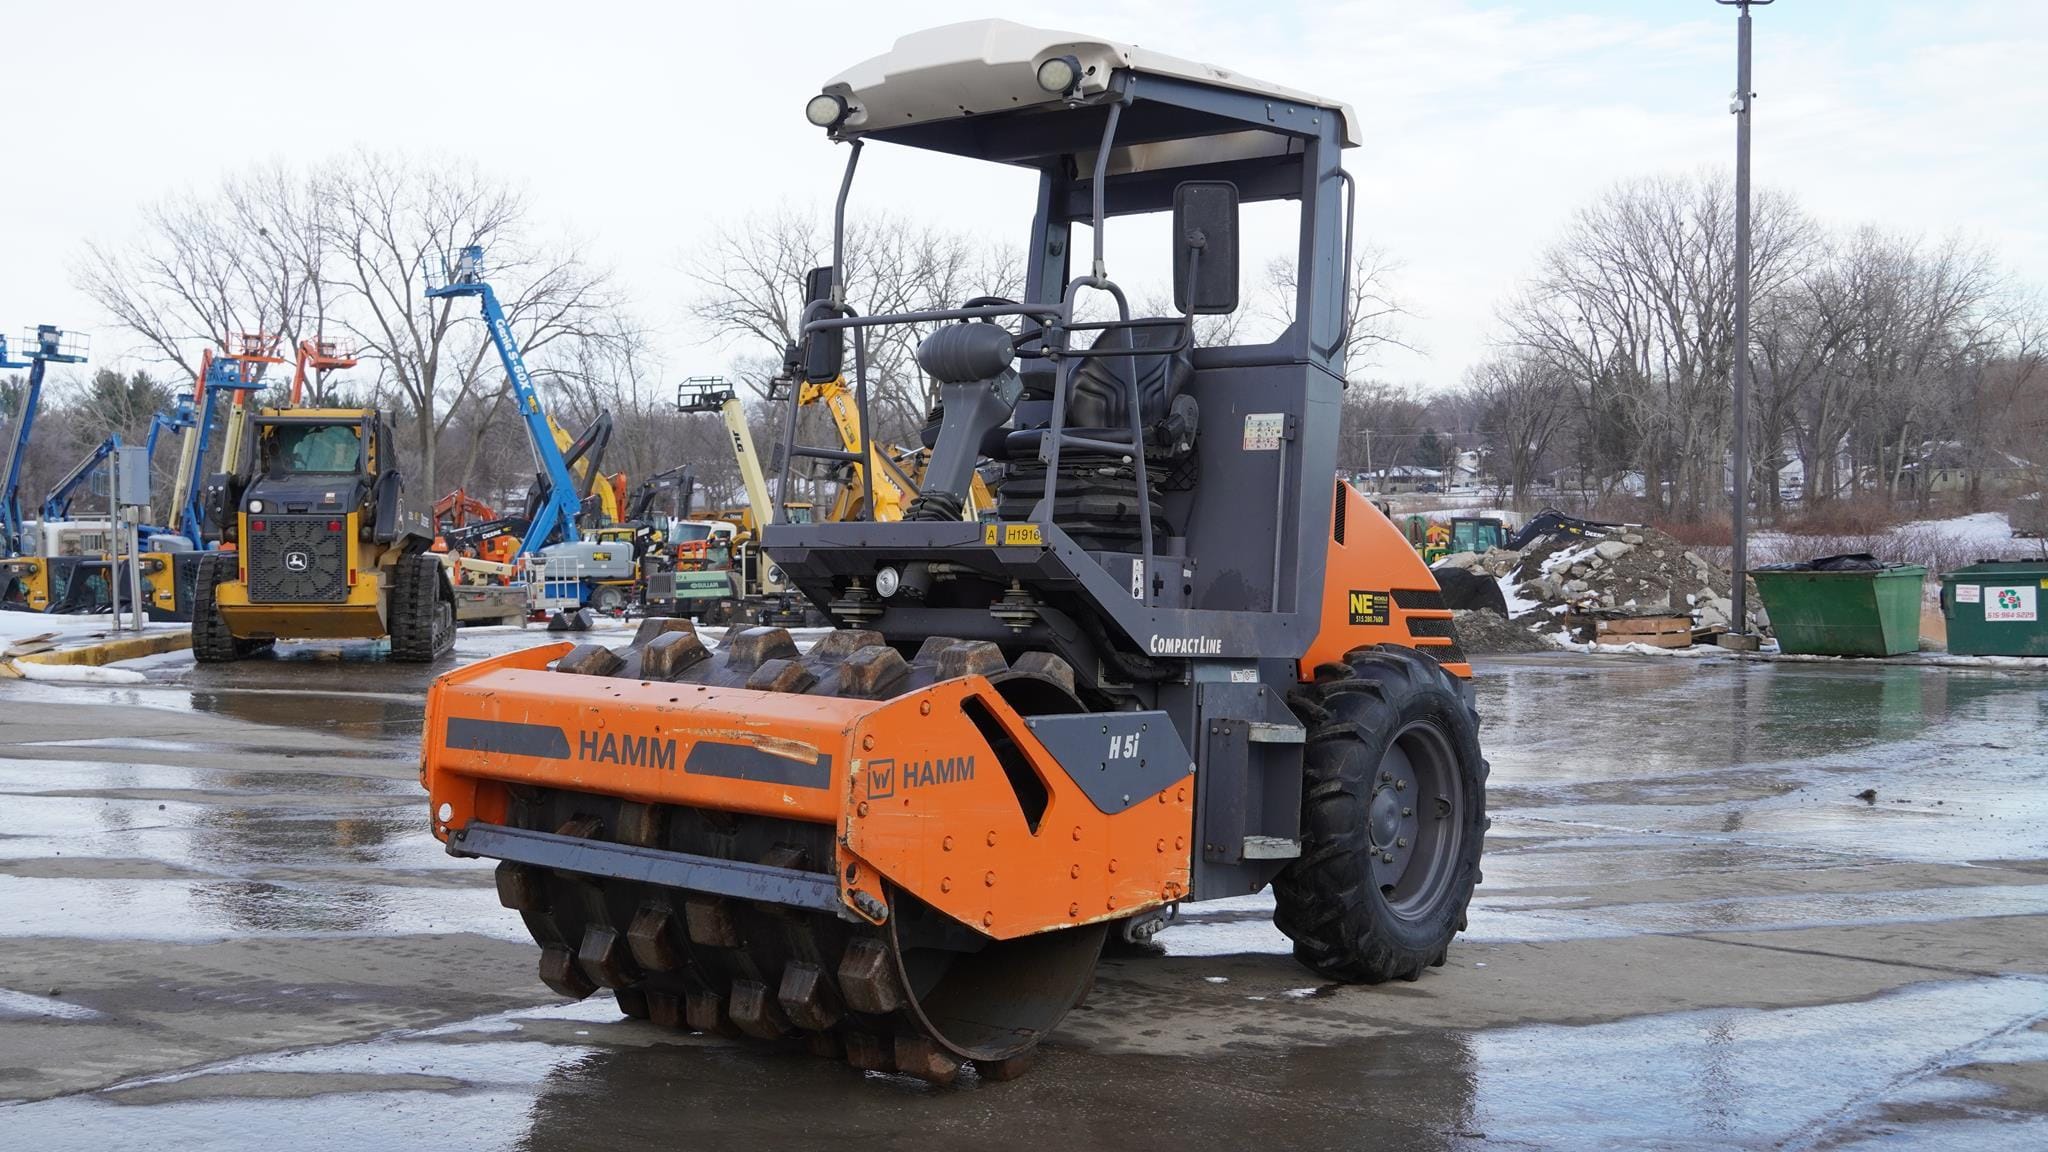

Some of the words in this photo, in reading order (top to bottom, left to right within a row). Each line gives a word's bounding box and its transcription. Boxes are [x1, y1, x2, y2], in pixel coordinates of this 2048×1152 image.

[496, 319, 513, 352] Genie
[508, 351, 531, 391] S-60X
[732, 430, 744, 452] JLG
[987, 529, 995, 540] A
[1350, 593, 1373, 614] NE
[578, 730, 676, 771] HAMM
[1109, 735, 1121, 759] H
[1123, 732, 1139, 758] 5i
[903, 755, 975, 789] HAMM
